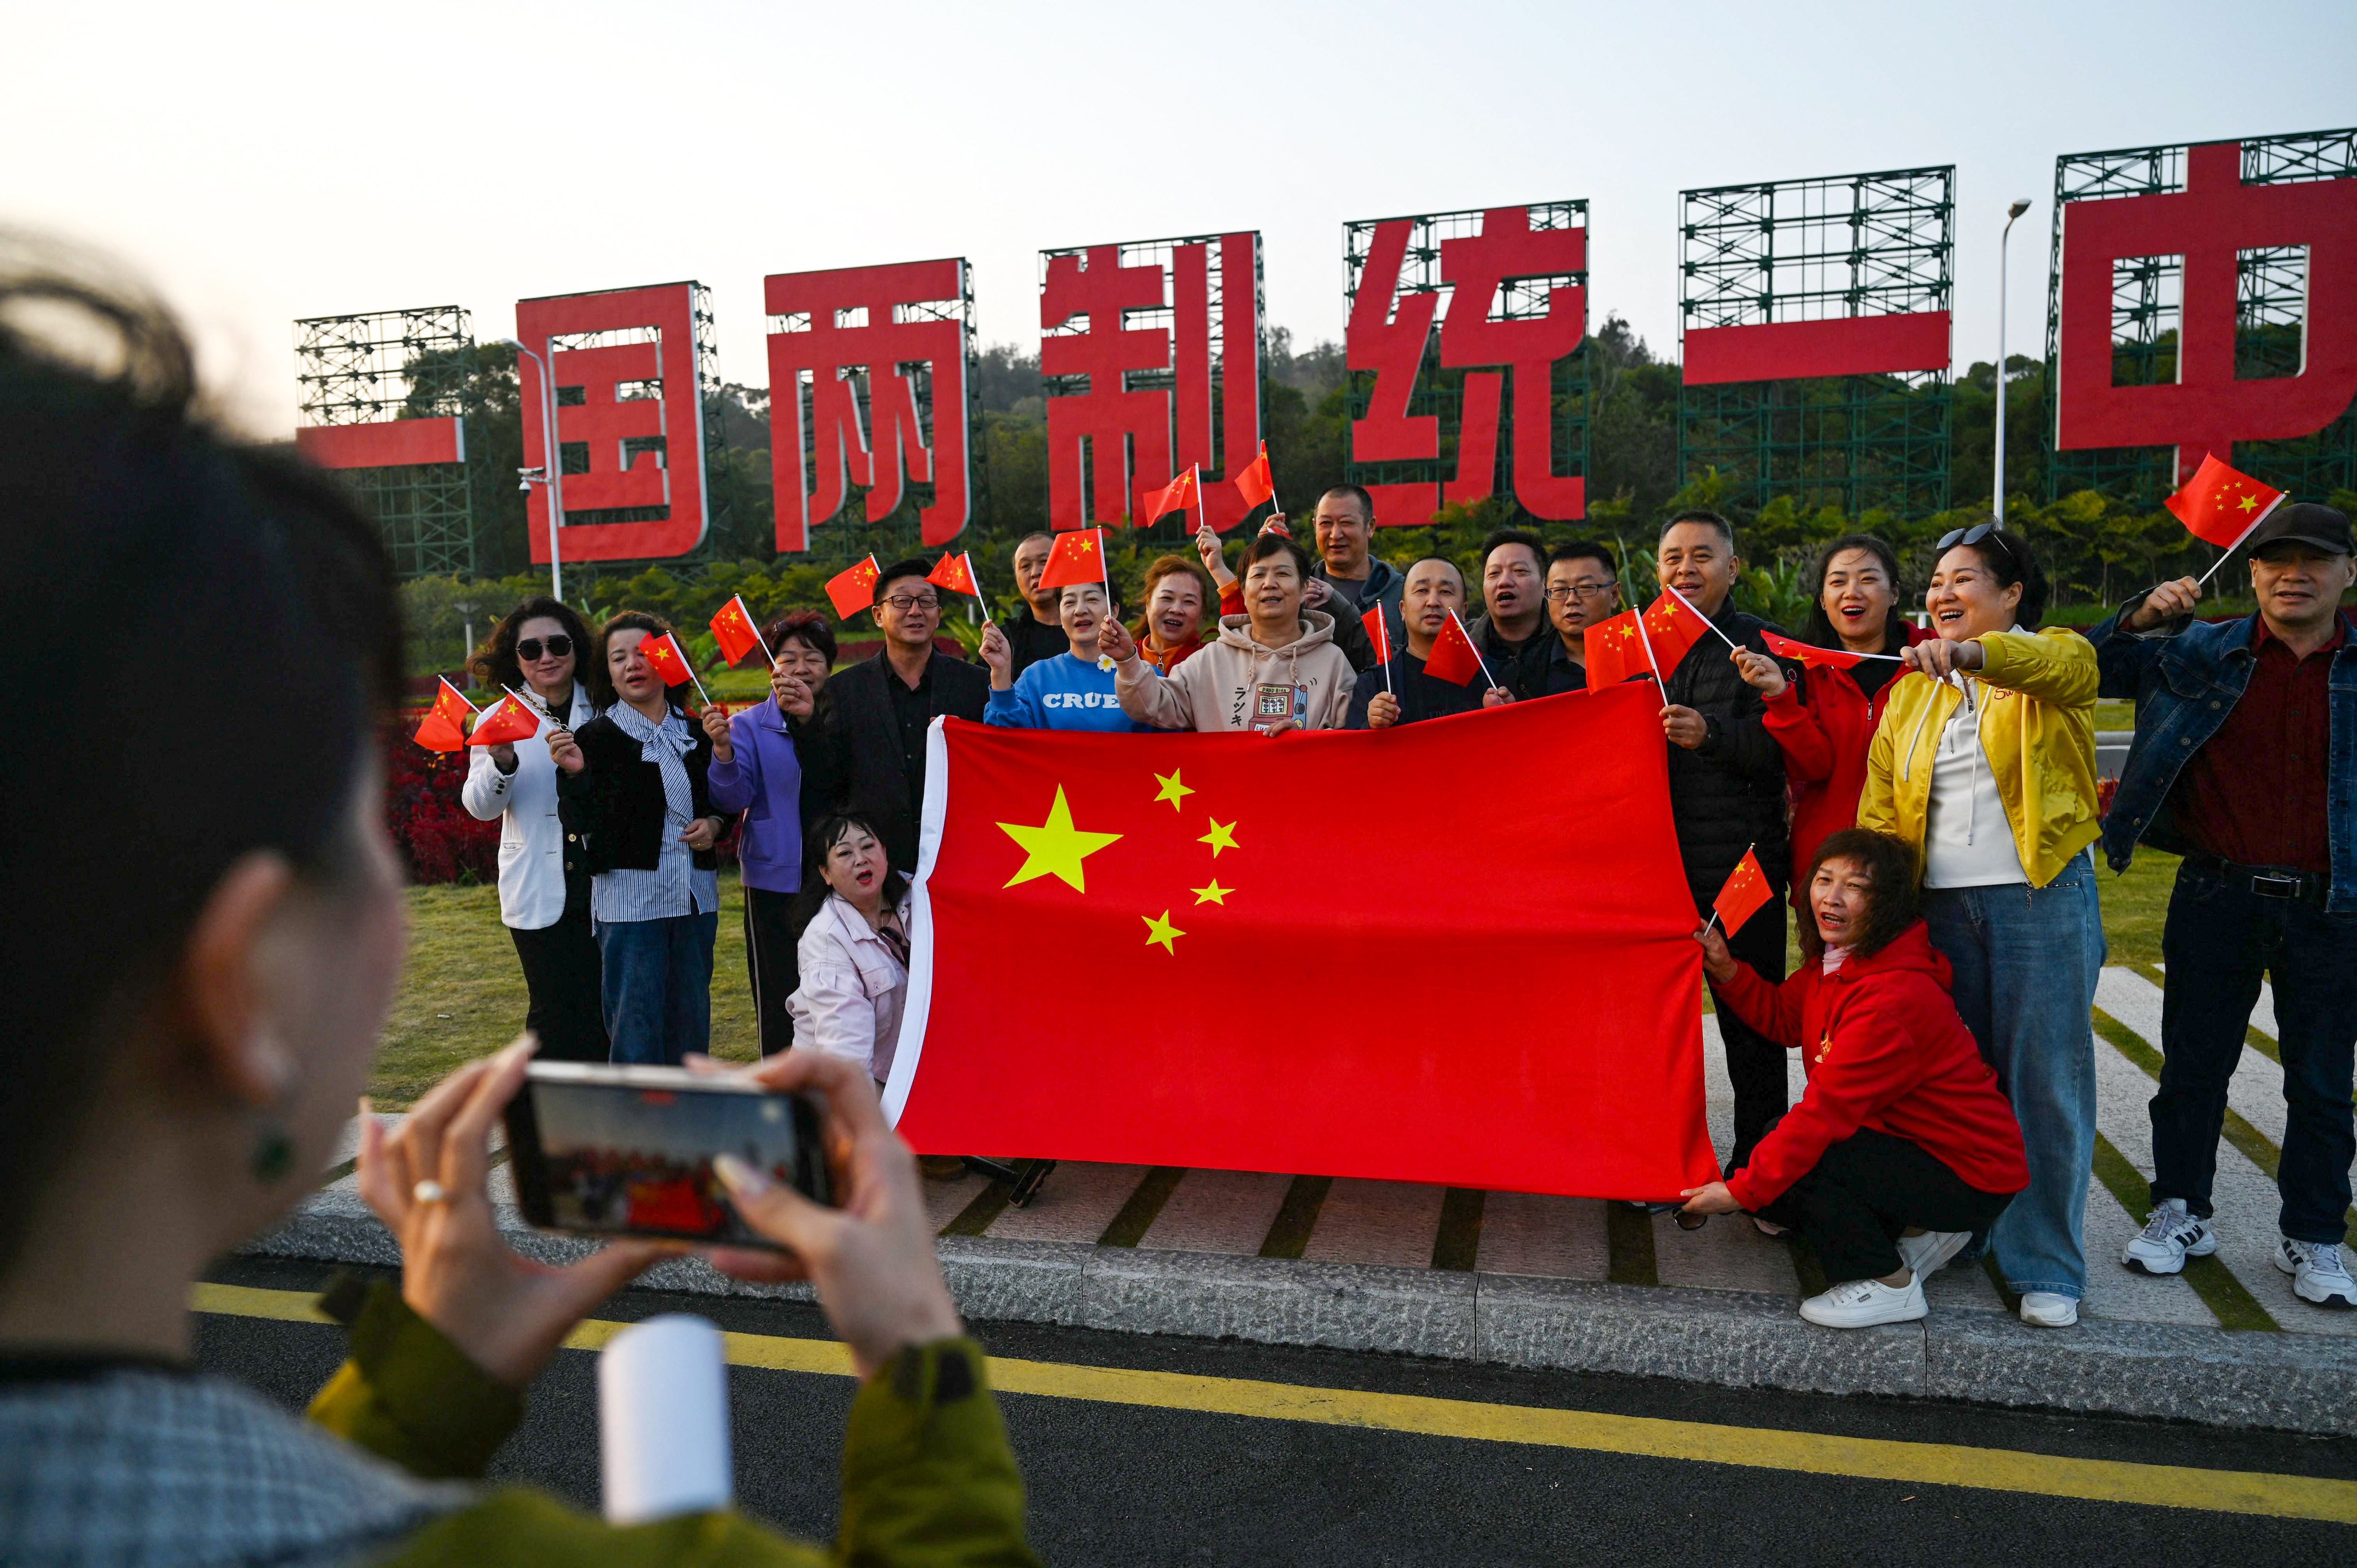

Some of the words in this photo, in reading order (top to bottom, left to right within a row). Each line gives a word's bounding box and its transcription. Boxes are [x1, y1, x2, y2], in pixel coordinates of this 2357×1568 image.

[296, 142, 2357, 563] 一国两制统一中
